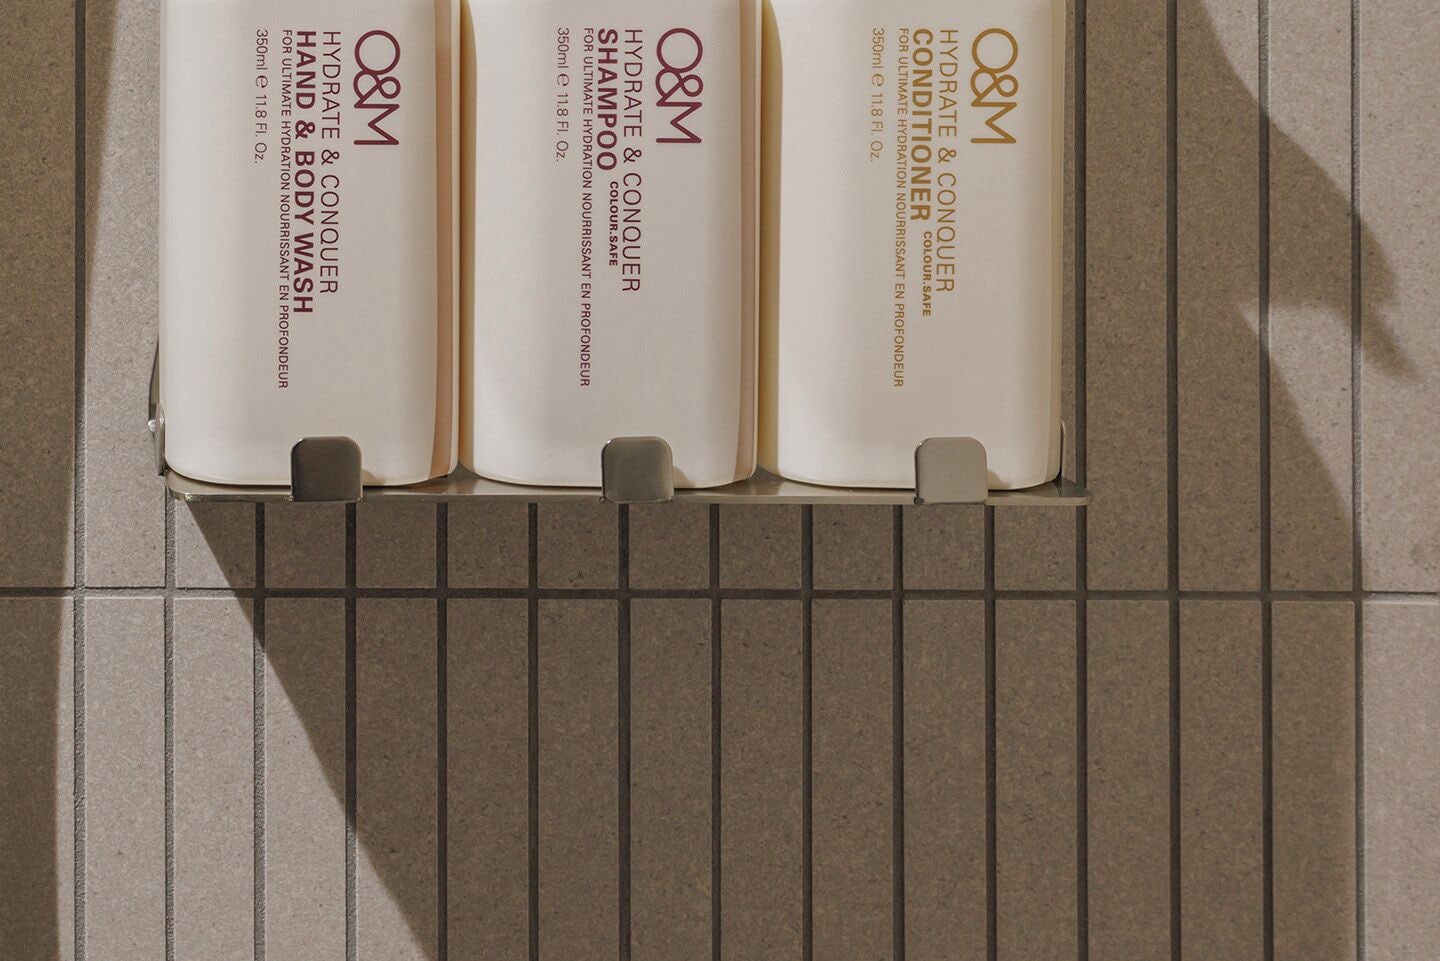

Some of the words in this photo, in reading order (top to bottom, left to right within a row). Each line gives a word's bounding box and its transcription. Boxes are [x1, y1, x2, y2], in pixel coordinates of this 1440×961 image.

[256, 28, 269, 71] 350ml
[281, 29, 293, 54] FOR
[556, 27, 570, 69] 350ml
[583, 27, 594, 52] FOR
[871, 27, 885, 69] 350ml
[898, 27, 909, 53] FOR
[281, 57, 292, 117] ULTIMATE
[295, 29, 316, 111] HAND
[321, 30, 341, 140] HYDRATE
[353, 29, 402, 147] O&M
[583, 55, 594, 115] ULTIMATE
[623, 28, 643, 138] HYDRATE
[655, 27, 704, 145] O&M
[897, 56, 909, 116] ULTIMATE
[937, 28, 959, 138] HYDRATE
[970, 27, 1020, 145] O&M
[254, 94, 267, 119] 11.8
[254, 122, 267, 138] Fl.
[294, 119, 316, 140] &
[556, 92, 569, 117] 11.8
[556, 120, 569, 136] Fl.
[870, 92, 884, 117] 11.8
[870, 120, 884, 136] Fl.
[254, 142, 267, 164] Oz.
[280, 120, 291, 191] HYDRATION
[320, 148, 341, 166] &
[555, 140, 569, 163] Oz.
[582, 118, 593, 189] HYDRATION
[596, 27, 617, 172] SHAMPOO
[608, 180, 619, 267] COLOUR.SAFE
[623, 146, 642, 164] &
[870, 140, 884, 163] Oz.
[897, 118, 908, 189] HYDRATION
[910, 27, 934, 222] CONDITIONER
[922, 230, 933, 317] COLOUR.SAFE
[937, 146, 957, 164] &
[294, 150, 315, 226] BODY
[279, 194, 291, 281] NOURRISSANT
[319, 173, 340, 295] CONQUER
[581, 192, 592, 279] NOURRISSANT
[621, 171, 642, 293] CONQUER
[896, 192, 907, 279] NOURRISSANT
[936, 171, 957, 293] CONQUER
[279, 284, 289, 301] EN
[293, 233, 314, 314] WASH
[580, 283, 591, 299] EN
[895, 283, 906, 299] EN
[277, 305, 289, 389] PROFONDEUR
[579, 303, 591, 387] PROFONDEUR
[893, 303, 905, 388] PROFONDEUR
